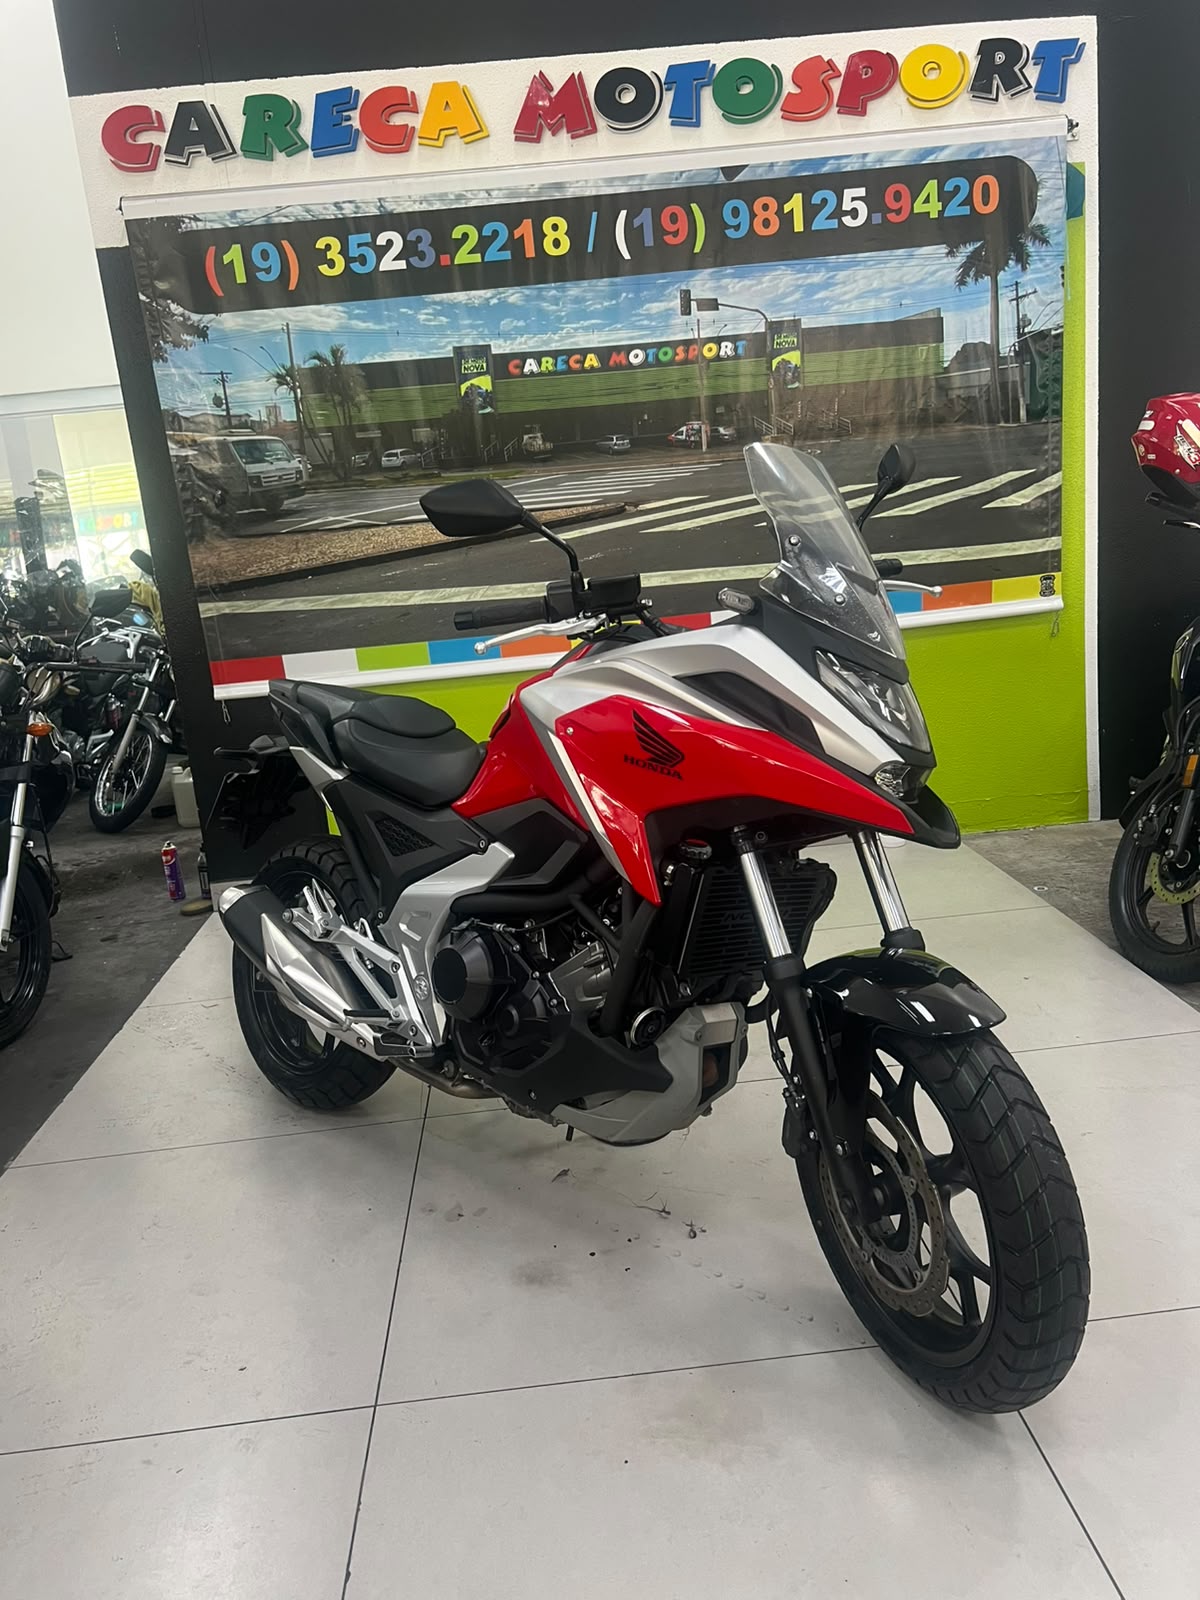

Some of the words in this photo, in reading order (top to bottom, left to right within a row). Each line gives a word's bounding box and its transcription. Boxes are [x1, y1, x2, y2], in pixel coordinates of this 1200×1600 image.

[101, 80, 489, 172] CARECA
[513, 37, 1086, 143] MOTOSPORT
[204, 238, 299, 297] (19)
[316, 216, 571, 277] 3523.2218
[587, 210, 598, 253] /
[614, 202, 706, 260] (19)
[722, 174, 1000, 239] 98125.9420
[508, 352, 601, 376] CARECA
[608, 340, 747, 367] MOTOSPORT
[774, 338, 797, 347] NOVA
[463, 363, 486, 373] NOVA
[623, 753, 684, 781] HONDA
